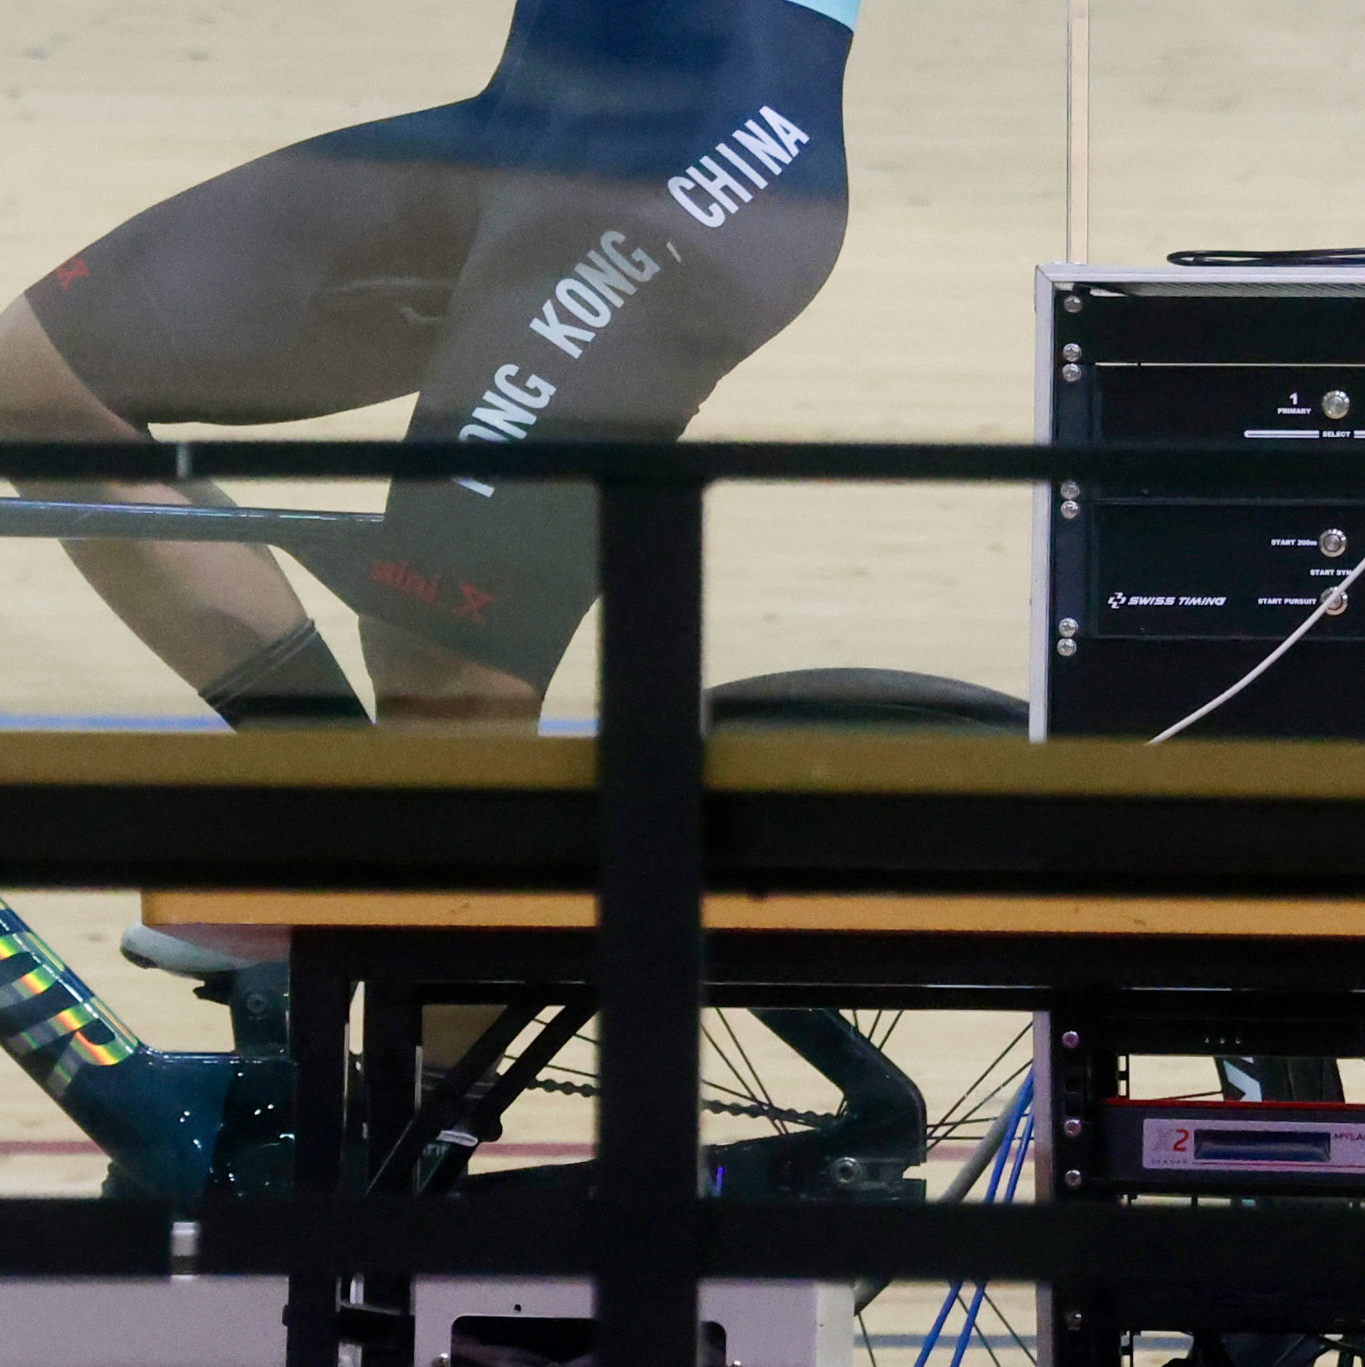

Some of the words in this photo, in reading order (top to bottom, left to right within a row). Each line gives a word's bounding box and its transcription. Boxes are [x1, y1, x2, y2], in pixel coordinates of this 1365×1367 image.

[667, 105, 810, 228] CHINA
[1289, 393, 1298, 405] 1
[1277, 407, 1312, 415] PRIMARY
[1271, 538, 1295, 547] START
[1310, 568, 1335, 576] START
[1127, 596, 1176, 606] SWISS
[1178, 596, 1227, 606] TIMING
[1257, 597, 1283, 605] START
[1284, 597, 1318, 606] PURSUIT
